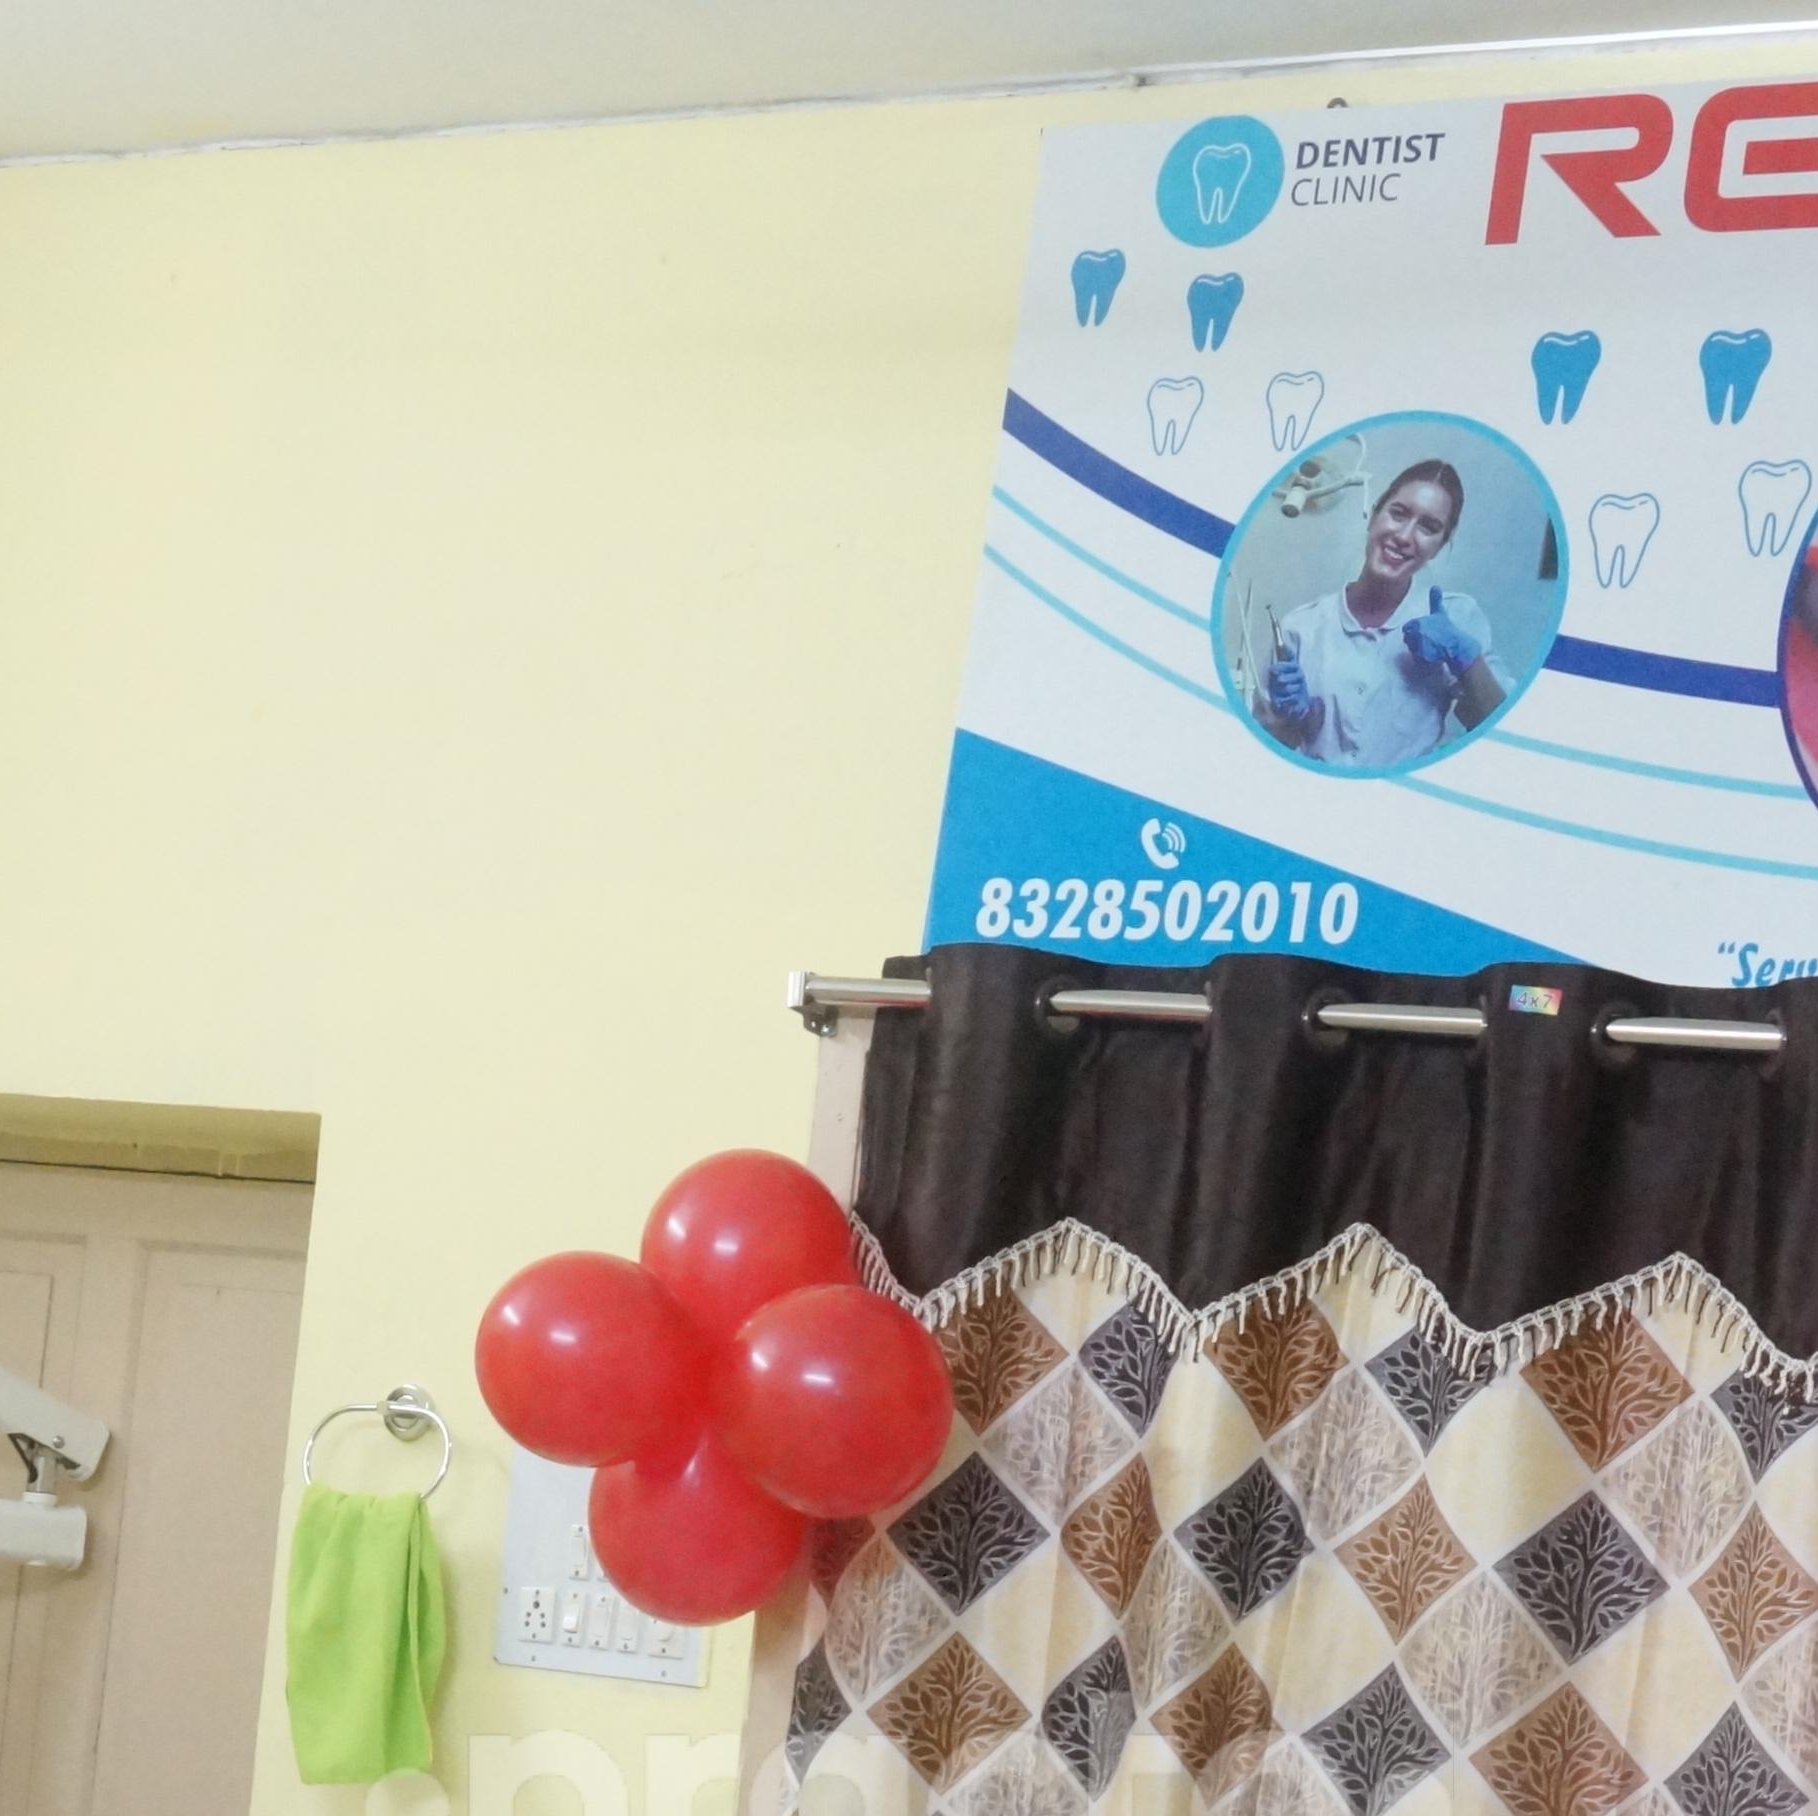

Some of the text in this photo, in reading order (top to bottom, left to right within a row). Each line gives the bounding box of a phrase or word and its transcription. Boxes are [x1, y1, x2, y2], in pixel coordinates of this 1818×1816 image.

[1295, 132, 1446, 170] DENTIST
[1290, 173, 1401, 207] CLINIC
[975, 876, 1360, 945] 8328502010
